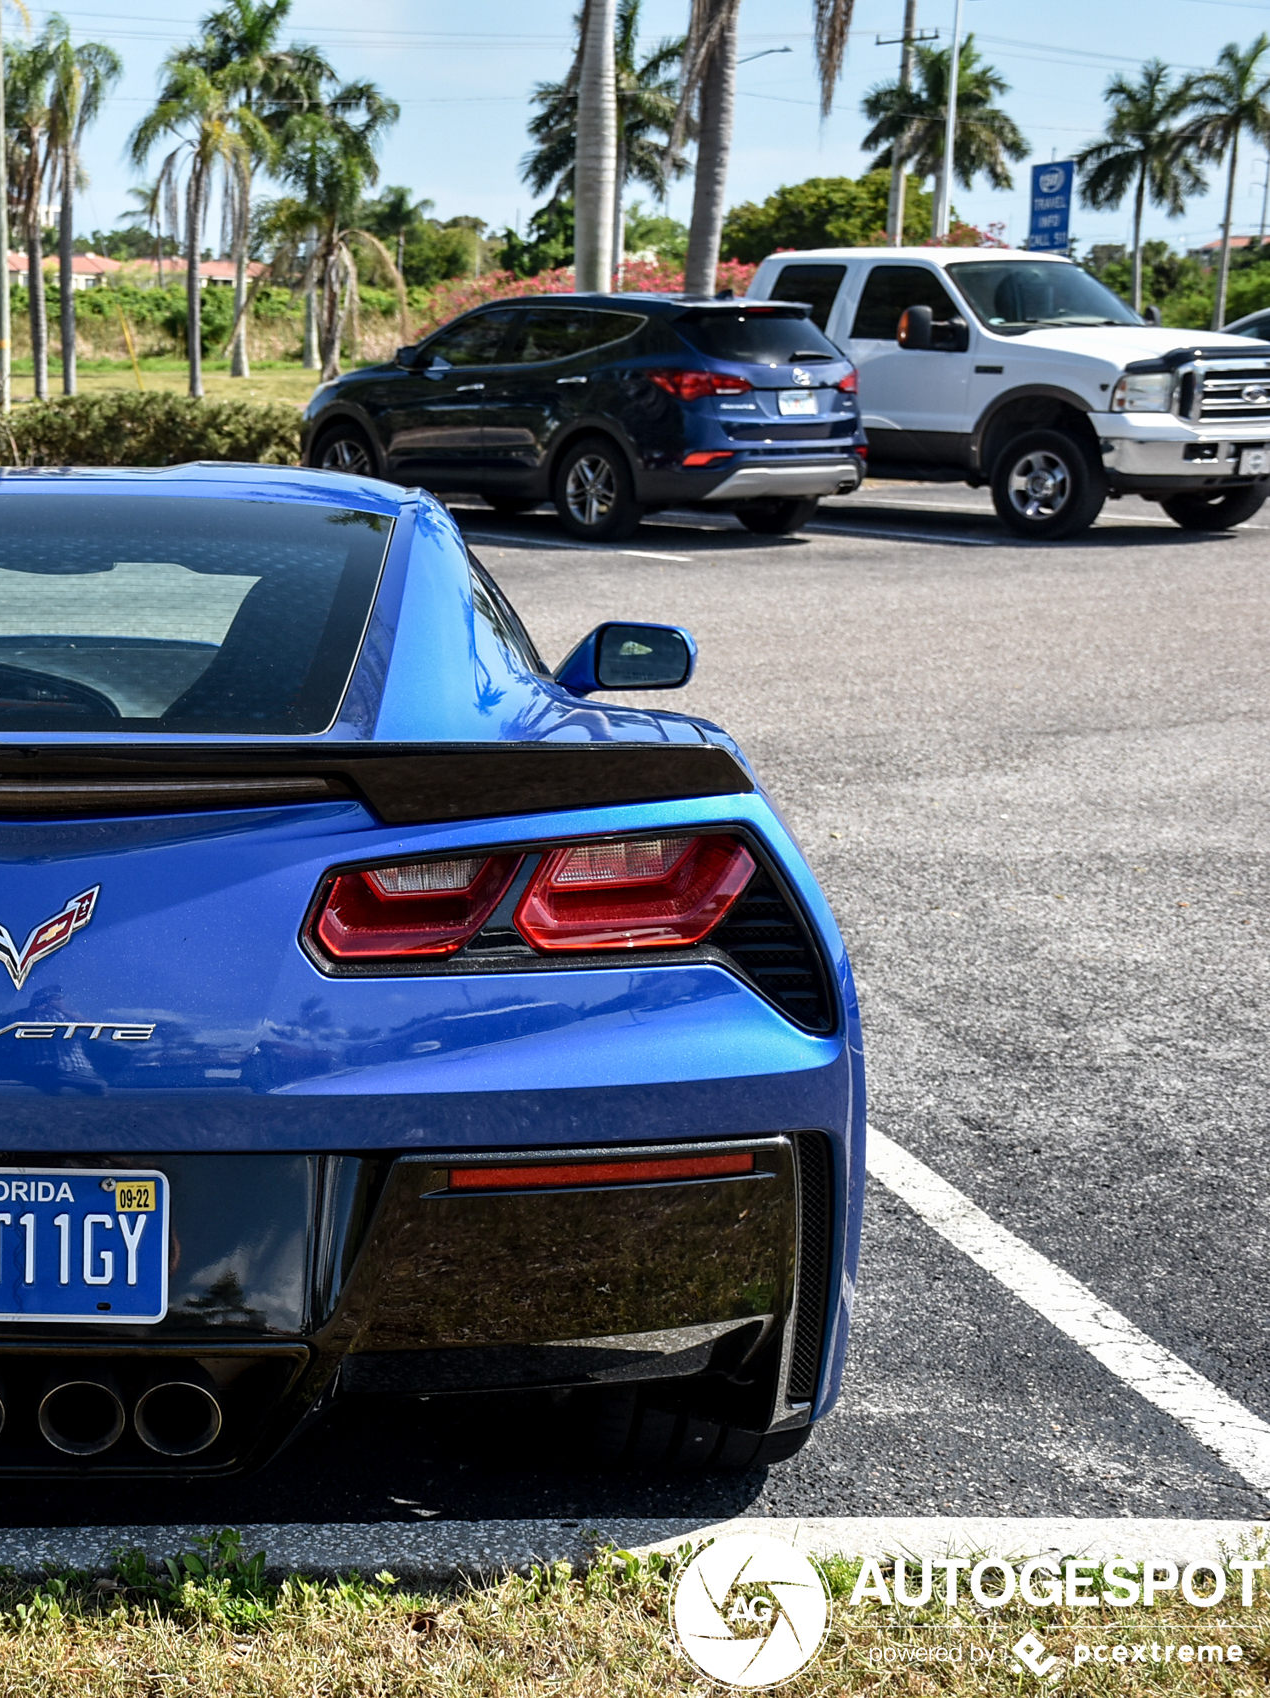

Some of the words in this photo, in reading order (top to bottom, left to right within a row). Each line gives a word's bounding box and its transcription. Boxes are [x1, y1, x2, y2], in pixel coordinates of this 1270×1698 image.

[1034, 196, 1067, 211] TRAVEL
[1038, 214, 1060, 228] INFO
[120, 1188, 150, 1209] 09-22
